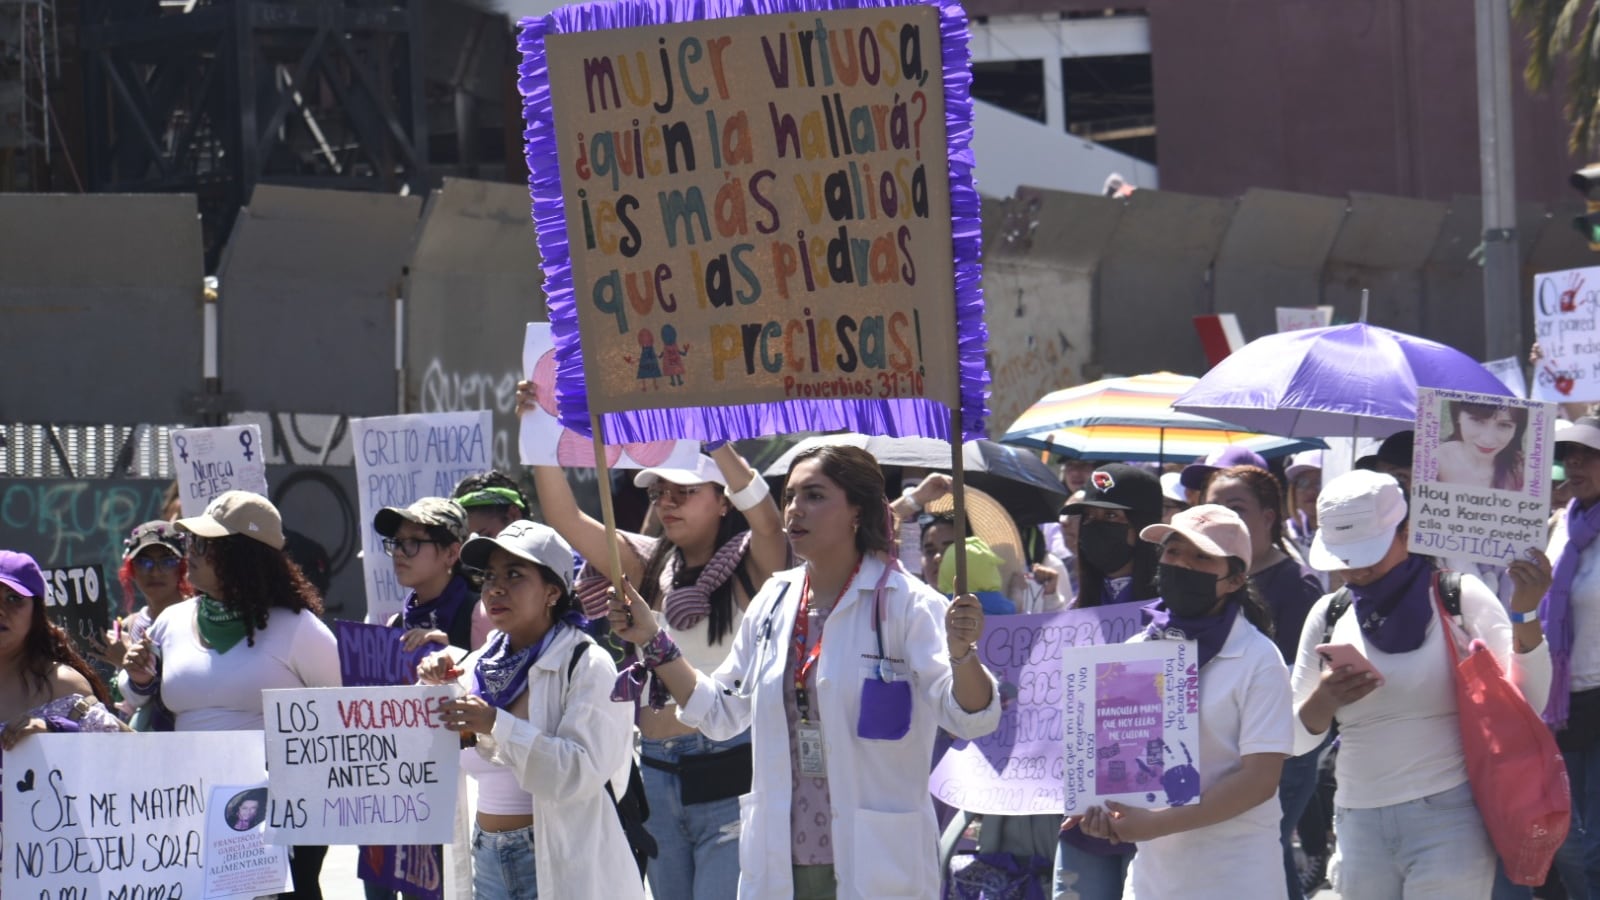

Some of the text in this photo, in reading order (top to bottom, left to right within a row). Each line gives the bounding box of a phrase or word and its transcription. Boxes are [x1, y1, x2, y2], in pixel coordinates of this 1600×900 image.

[584, 17, 929, 113] mujer virtuosa,
[575, 91, 927, 191] ¿quién la hallará?
[658, 169, 781, 248] más
[794, 158, 929, 225] valiosa
[592, 225, 916, 334] que las piedras
[711, 307, 926, 381] preciosas!
[784, 371, 925, 398] Proverbios 31:10
[363, 428, 418, 467] GRITO
[425, 423, 485, 463] AHORA
[192, 459, 234, 480] Nunca
[190, 479, 232, 500] DEJES
[368, 470, 422, 509] PORQUE
[1456, 492, 1512, 508] marcho
[1518, 501, 1543, 514] por
[1418, 518, 1442, 530] ella
[1447, 522, 1464, 534] ya
[1469, 523, 1485, 536] no
[1420, 503, 1543, 529] Ana Karen porque
[1414, 531, 1516, 560] #JUSTICIA
[1164, 658, 1176, 691] estoy
[1175, 643, 1188, 730] peleando como
[1184, 662, 1198, 714] NIÑA
[277, 695, 450, 733] LOS VIOLADORE
[1065, 719, 1074, 735] mi
[1076, 700, 1086, 751] regresar
[1097, 705, 1138, 717] TRANQUILA
[1102, 716, 1156, 729] QUE HOY ELLAS
[286, 733, 398, 765] EXISTIERON
[1109, 729, 1150, 741] ME CUIDAN
[1066, 743, 1076, 764] que
[1087, 733, 1095, 778] a casa
[328, 760, 439, 789] ANTES QUE
[1065, 768, 1076, 811] Quiero
[90, 792, 121, 828] ME
[131, 777, 206, 825] MATAN
[270, 792, 431, 829] LAS MINIFALDAS
[16, 830, 203, 879] NO DEJEN SOLA
[209, 855, 278, 876] ALIMENTARIO!
